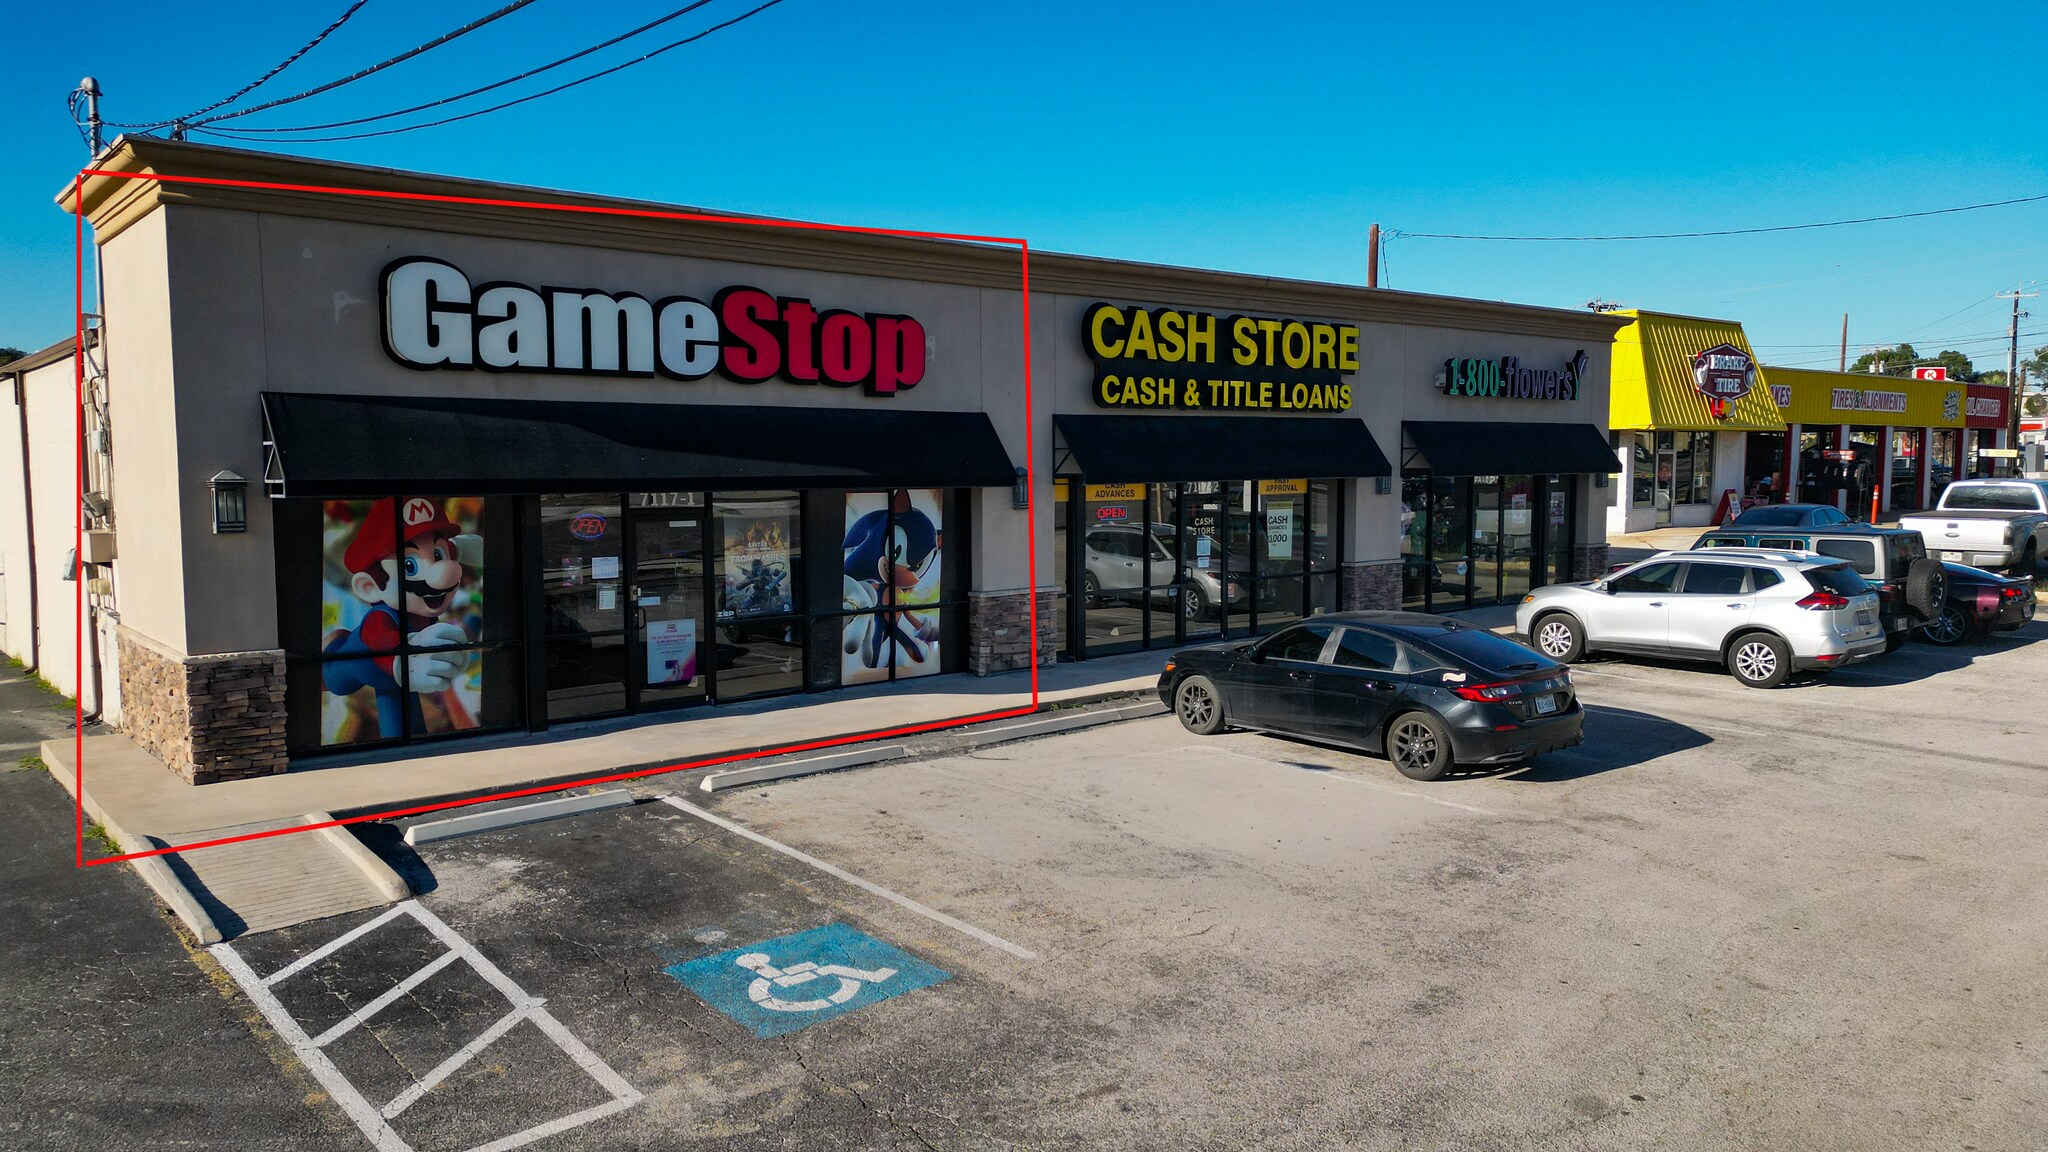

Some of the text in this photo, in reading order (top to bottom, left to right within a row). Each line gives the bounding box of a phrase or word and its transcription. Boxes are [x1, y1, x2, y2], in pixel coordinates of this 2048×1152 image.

[382, 258, 926, 394] GameStop
[1091, 306, 1360, 370] CASH STORE
[1711, 354, 1746, 370] BRAKE
[1101, 374, 1352, 409] CASH & TITLE LOANS
[1715, 378, 1740, 393] TIRE
[1832, 389, 1854, 409] TIRES
[1861, 391, 1907, 412] ALIGNMENTS
[640, 492, 695, 507] 7117-1
[1095, 489, 1135, 498] ADVANCES
[1096, 508, 1126, 519] OPEN
[1268, 515, 1288, 525] CASH
[570, 518, 606, 534] OPEN
[1194, 517, 1214, 526] CASH
[1192, 527, 1216, 536] STORE
[731, 555, 753, 563] FROM
[761, 553, 785, 561] ASHES
